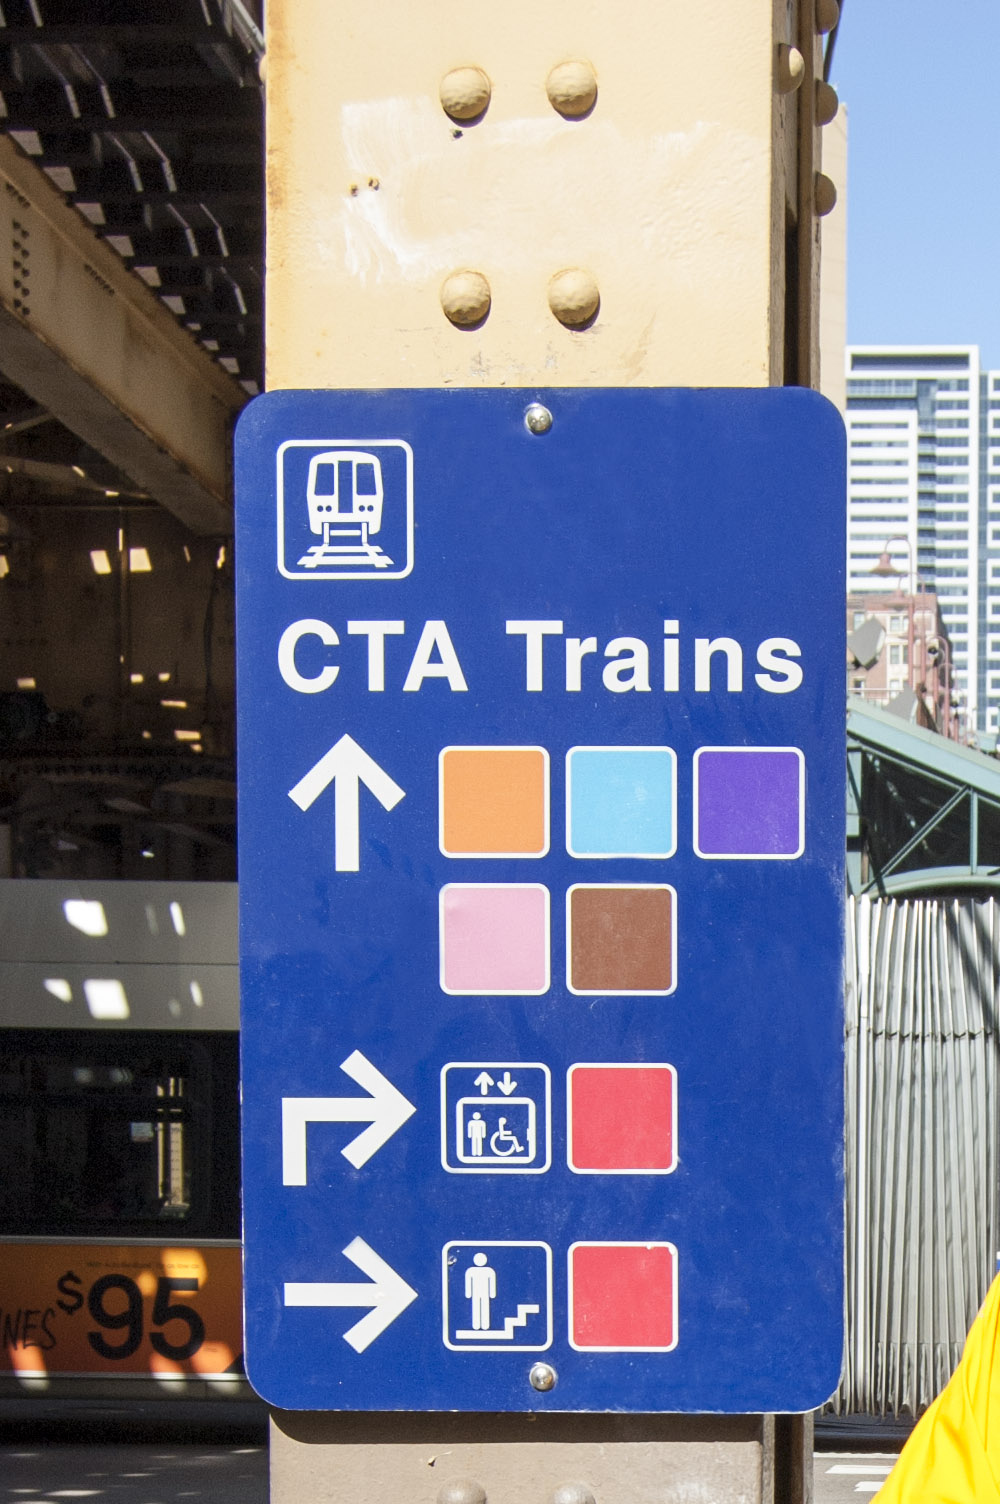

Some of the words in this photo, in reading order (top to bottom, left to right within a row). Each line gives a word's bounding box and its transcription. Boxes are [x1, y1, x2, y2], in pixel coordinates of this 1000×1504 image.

[278, 619, 468, 693] CTA
[506, 620, 804, 693] Trains
[56, 1270, 206, 1361] $95
